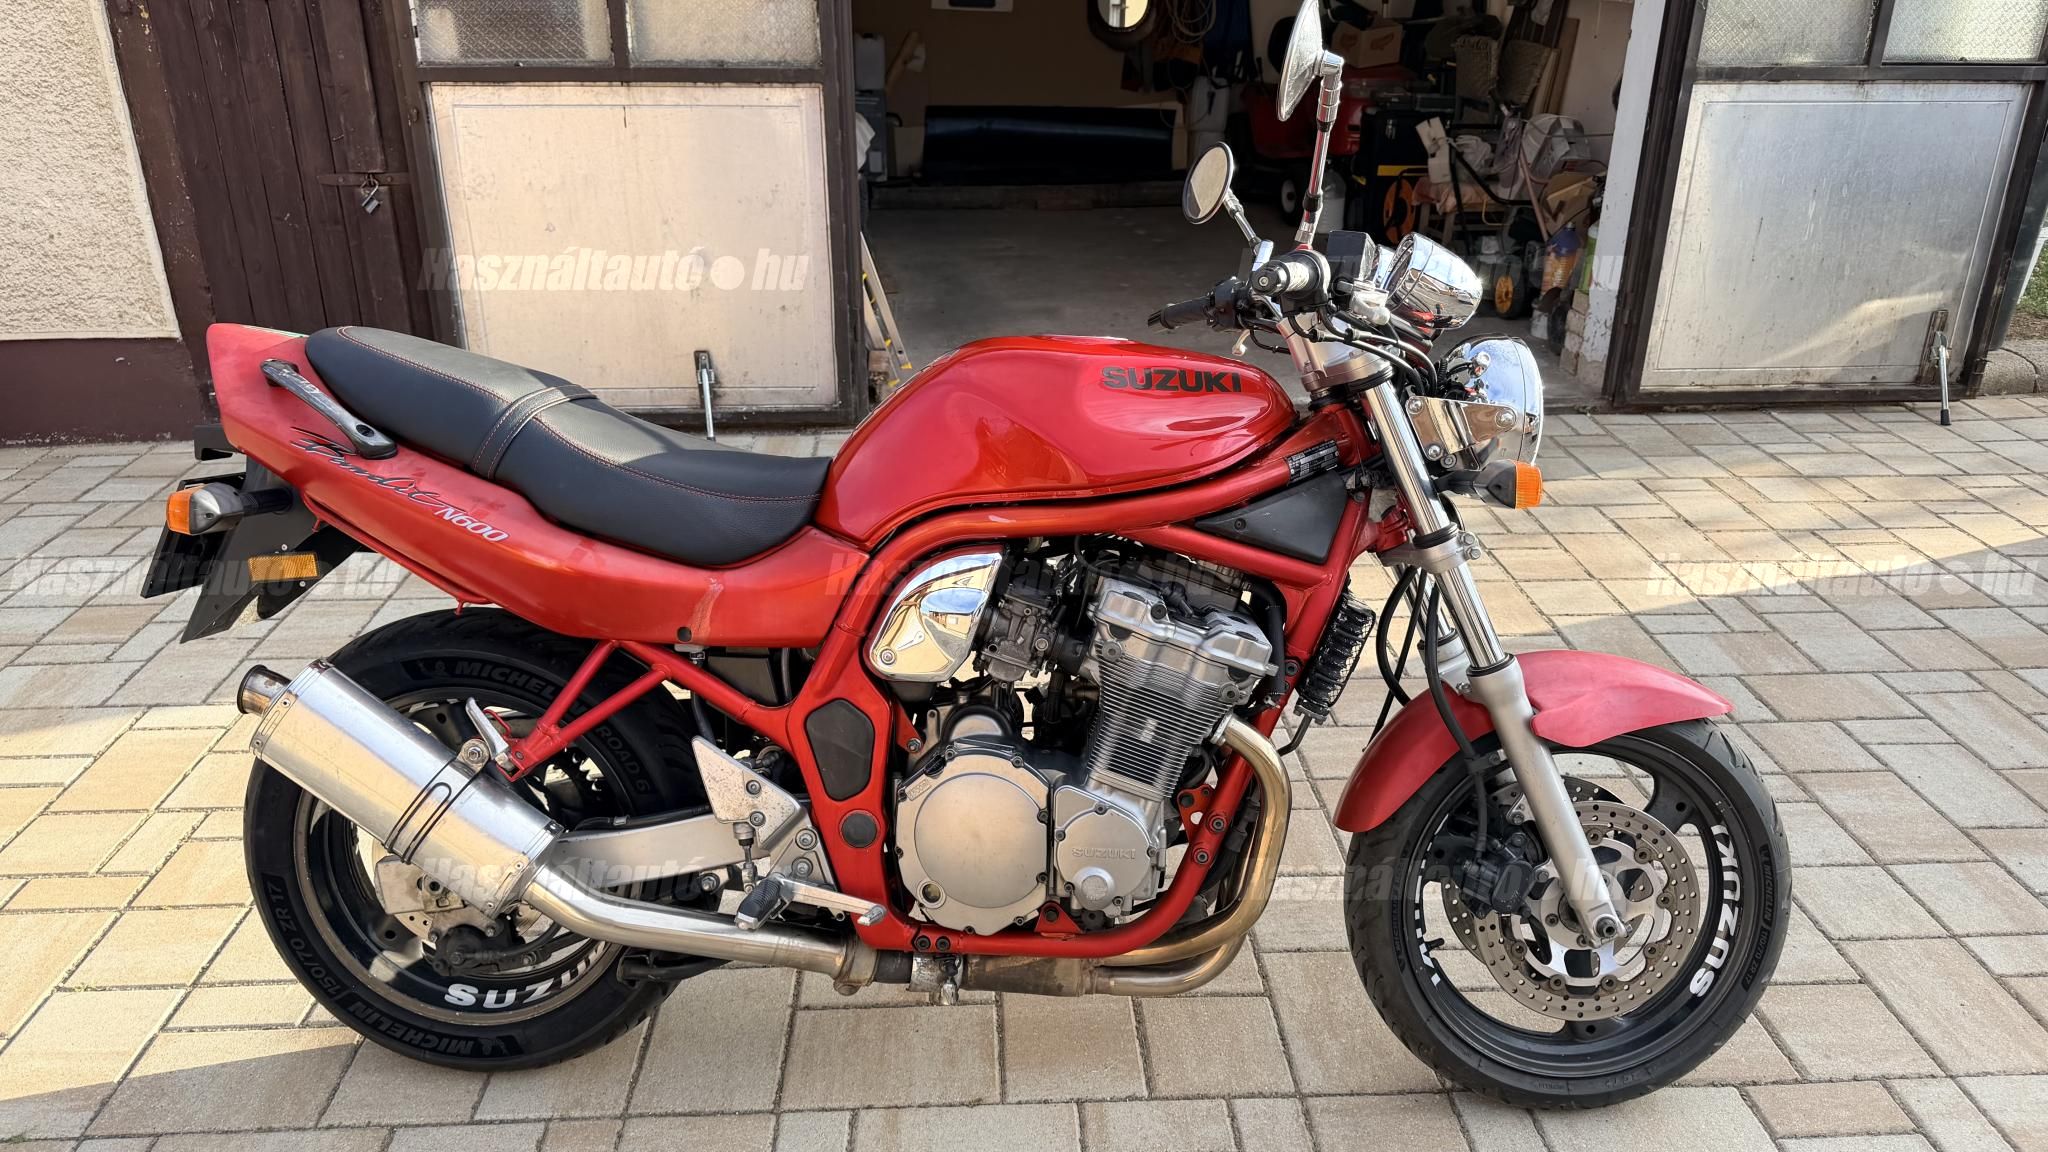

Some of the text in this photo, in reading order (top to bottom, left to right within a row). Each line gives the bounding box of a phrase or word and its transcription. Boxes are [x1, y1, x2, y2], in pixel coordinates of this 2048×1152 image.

[1102, 367, 1242, 393] SUZUKI
[290, 426, 511, 543] Bandit N600
[455, 660, 592, 722] MICHELN
[594, 726, 641, 777] ROAD
[1071, 847, 1137, 860] SUZUKI
[1690, 825, 1741, 998] SUZUKI
[1763, 865, 1775, 923] MICHELIN
[268, 882, 342, 997] 150/70 ZR 17
[347, 1001, 477, 1056] MICHELIN
